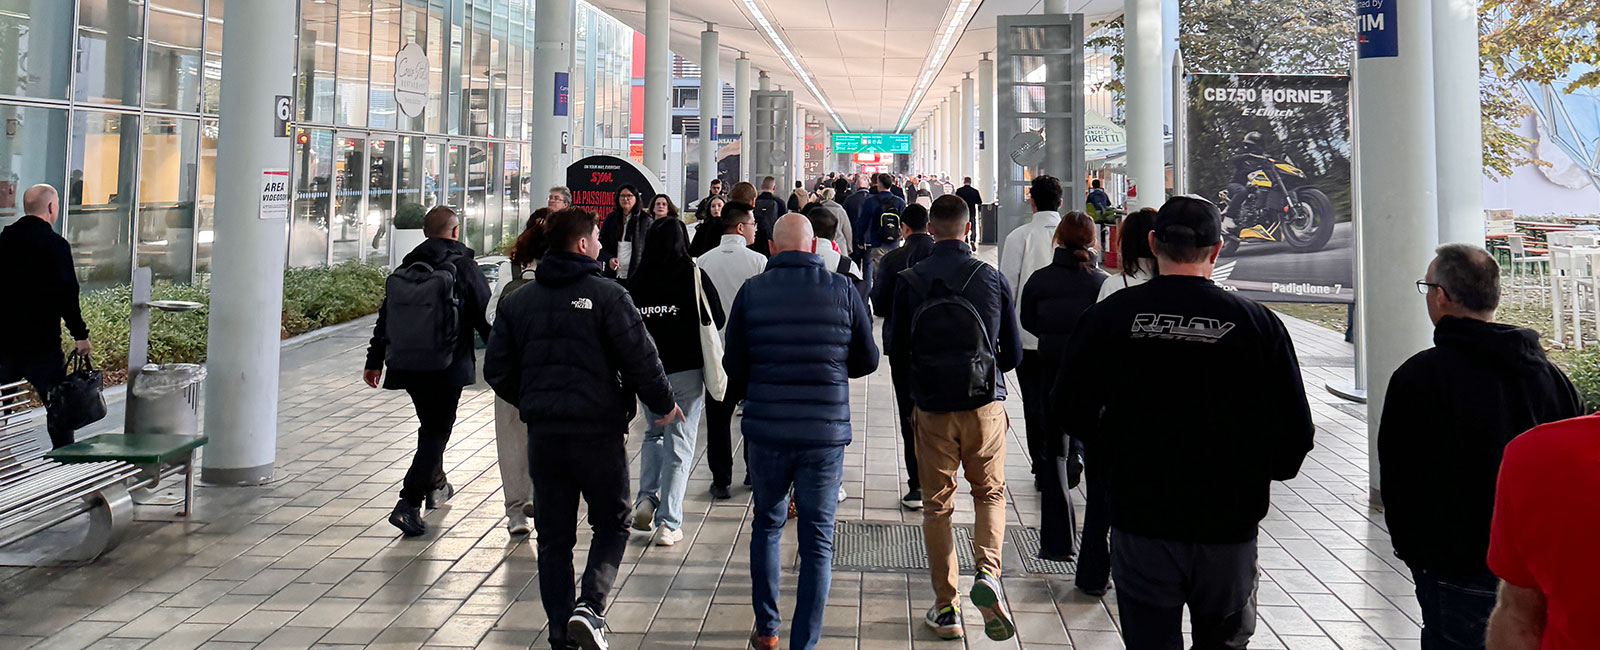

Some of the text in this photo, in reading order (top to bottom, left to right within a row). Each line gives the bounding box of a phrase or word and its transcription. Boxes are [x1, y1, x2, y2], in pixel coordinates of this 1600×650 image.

[1356, 13, 1384, 32] TIM
[1203, 87, 1332, 103] CB750 HORNET
[1085, 134, 1120, 142] ORETTI
[264, 182, 285, 192] AREA
[572, 190, 616, 206] LA PASSIONE
[1272, 282, 1342, 295] Padiglione 7
